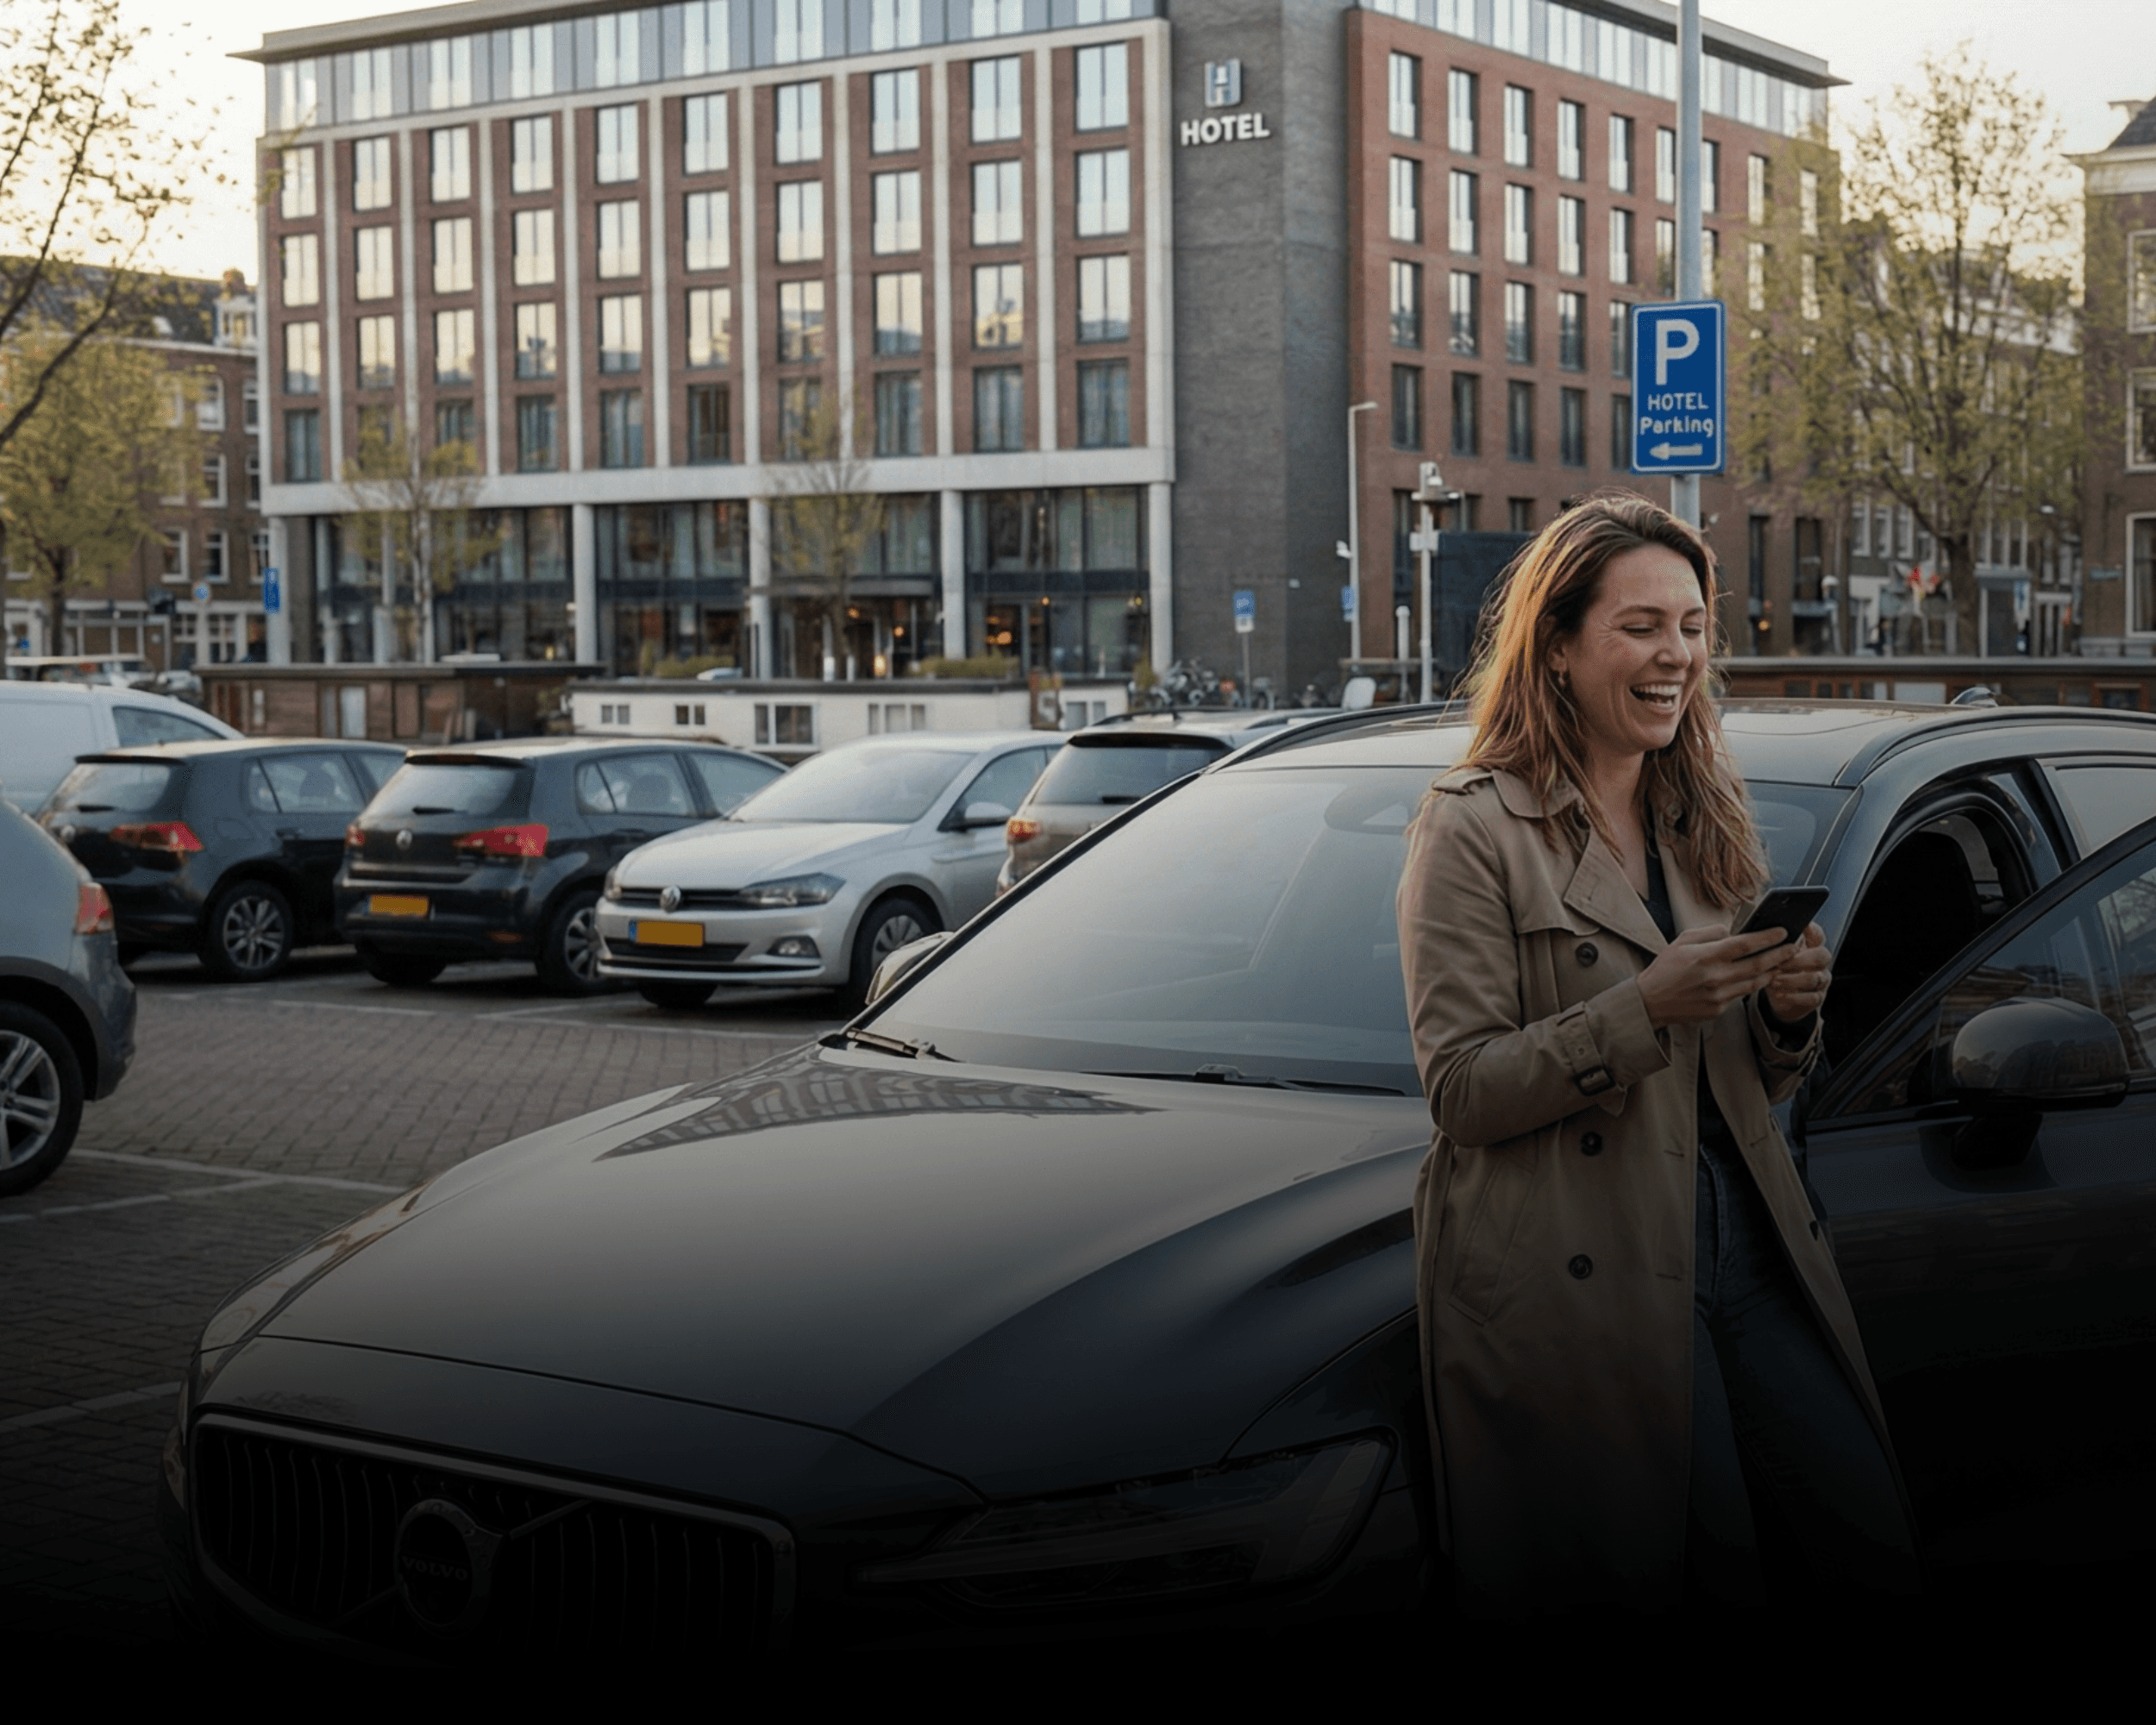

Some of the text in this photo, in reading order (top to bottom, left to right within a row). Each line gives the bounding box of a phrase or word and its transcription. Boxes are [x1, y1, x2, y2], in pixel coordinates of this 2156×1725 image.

[1181, 111, 1270, 146] HOTEL
[1655, 319, 1700, 386] P
[1647, 392, 1708, 412] HOTEL
[401, 1555, 467, 1581] VOLVO
